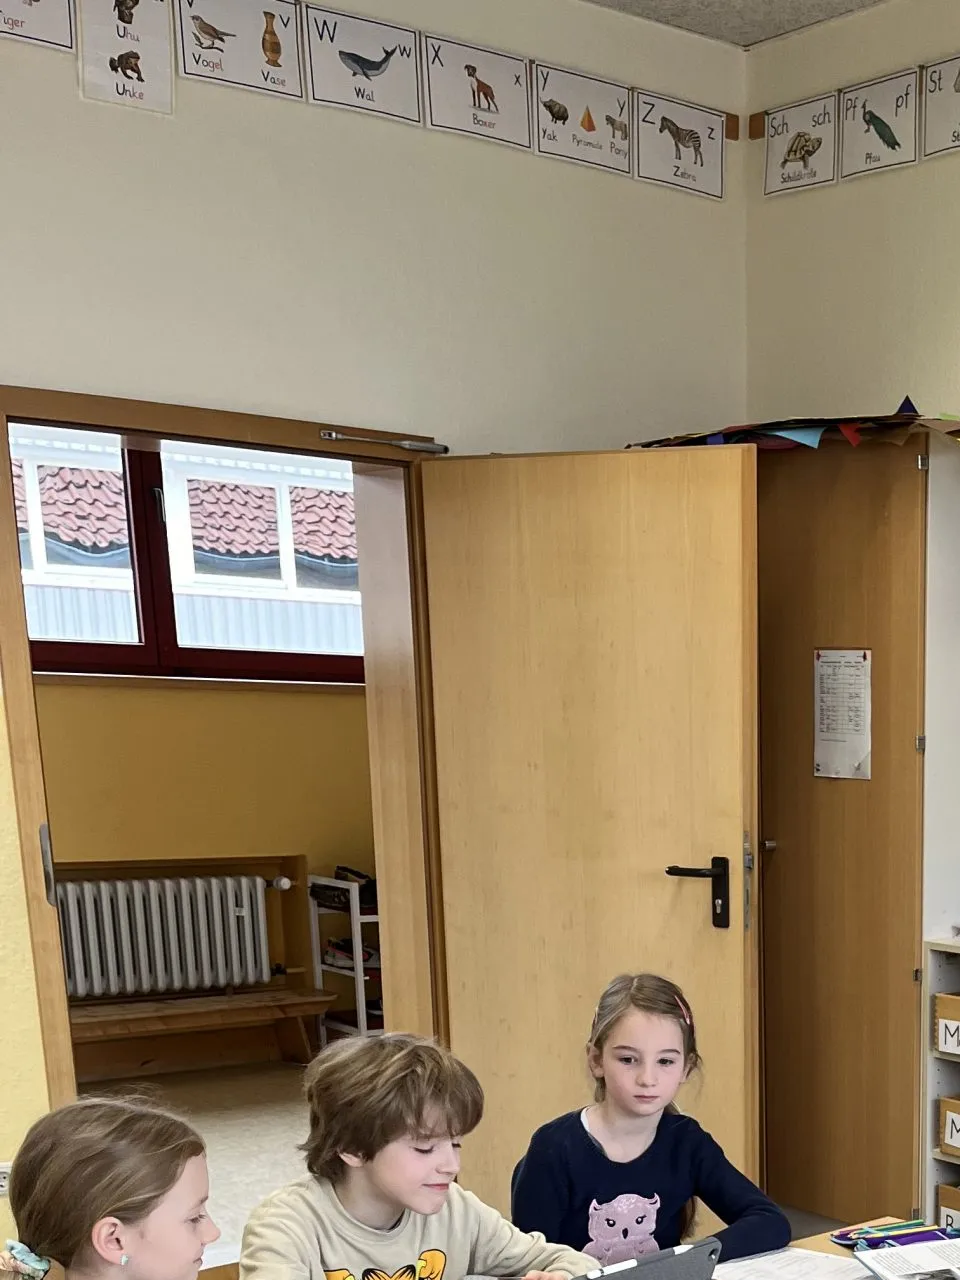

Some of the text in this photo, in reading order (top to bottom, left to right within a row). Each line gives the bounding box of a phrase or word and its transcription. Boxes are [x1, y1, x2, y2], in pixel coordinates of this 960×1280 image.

[0, 10, 26, 30] iger
[314, 19, 338, 43] W
[116, 24, 140, 42] Uhu
[192, 52, 223, 72] Vogel
[431, 44, 444, 67] X
[261, 69, 286, 87] Vase
[928, 70, 943, 93] St
[115, 82, 144, 100] Unke
[354, 87, 375, 102] Wal
[895, 84, 911, 117] pf
[642, 101, 656, 125] Z
[811, 104, 832, 127] sch
[845, 97, 859, 120] Pf
[472, 113, 496, 129] Boxer
[769, 115, 789, 138] Sch
